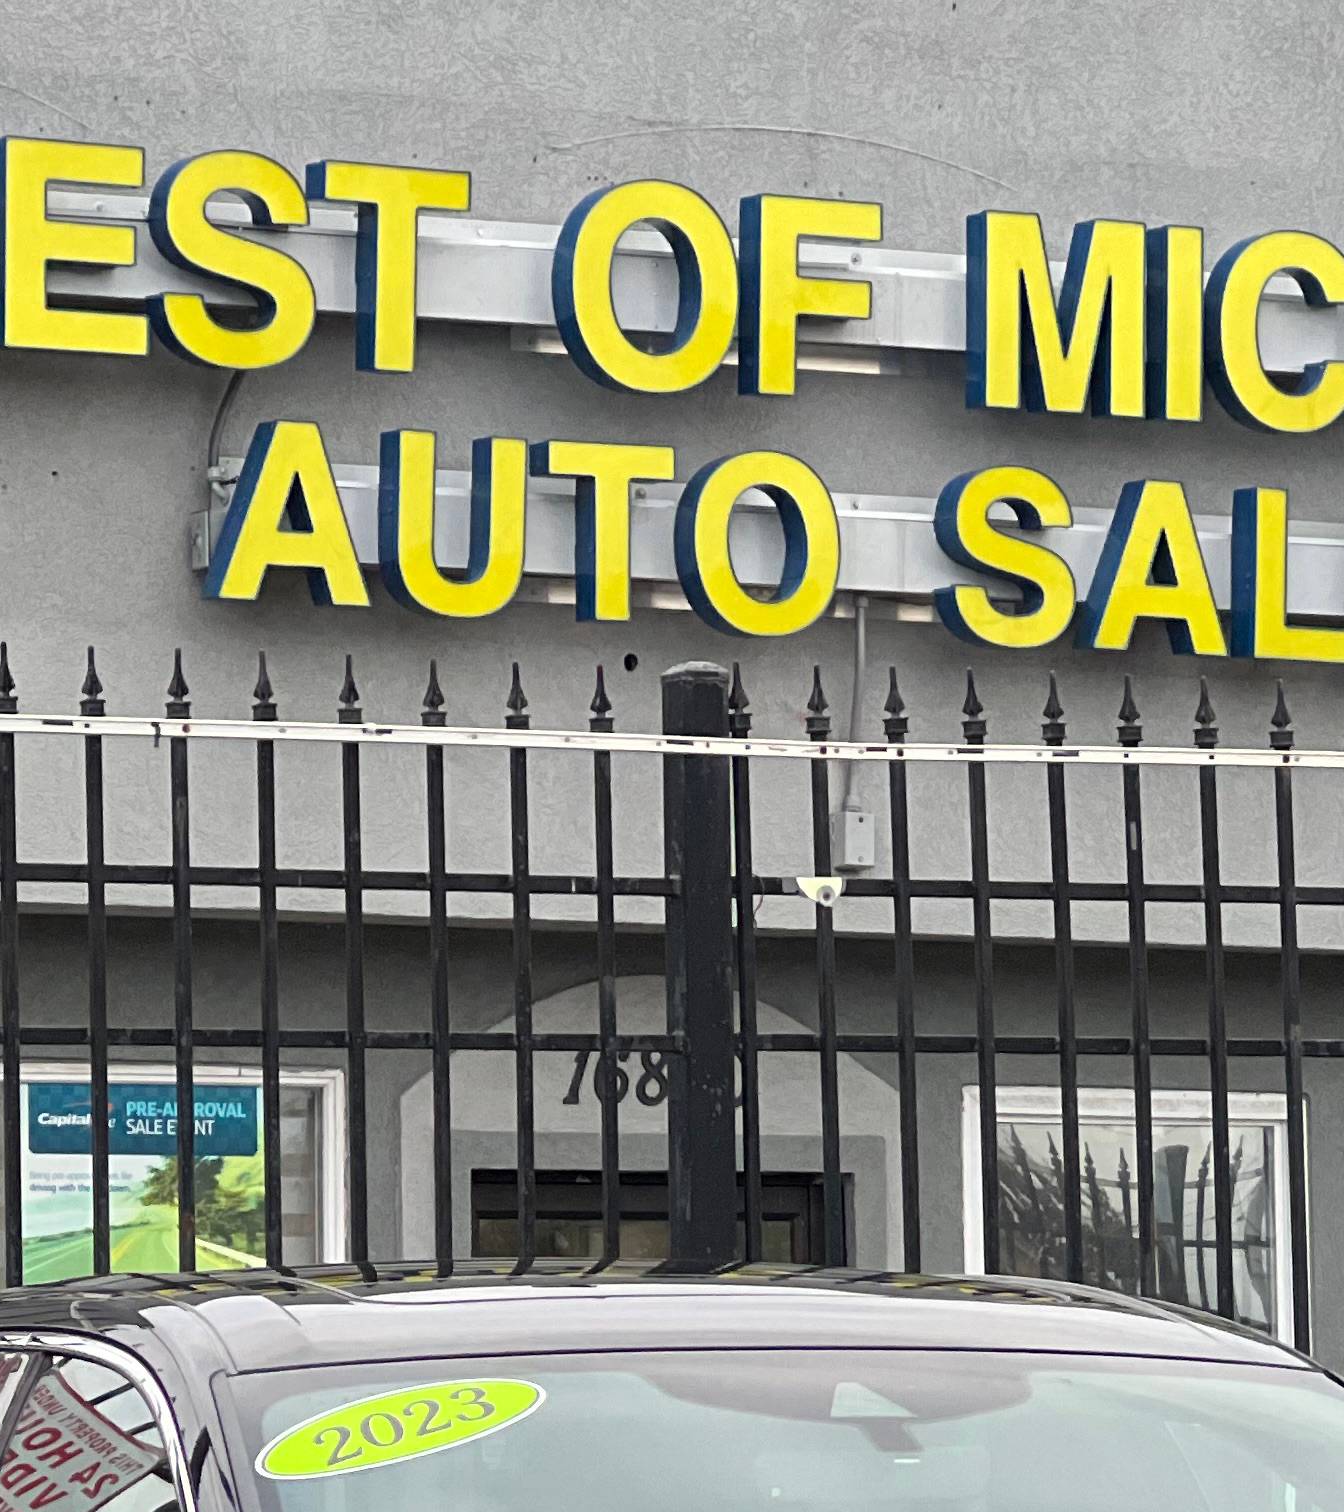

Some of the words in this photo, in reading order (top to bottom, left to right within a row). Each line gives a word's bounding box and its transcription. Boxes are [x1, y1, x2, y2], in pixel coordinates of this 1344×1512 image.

[560, 177, 884, 396] OF
[208, 419, 841, 637] AUTO
[37, 1112, 92, 1128] Capital
[126, 1100, 246, 1118] PRE-AROVAL
[126, 1118, 163, 1136] SALE
[167, 1118, 216, 1136] ENT
[313, 1387, 495, 1466] 2023
